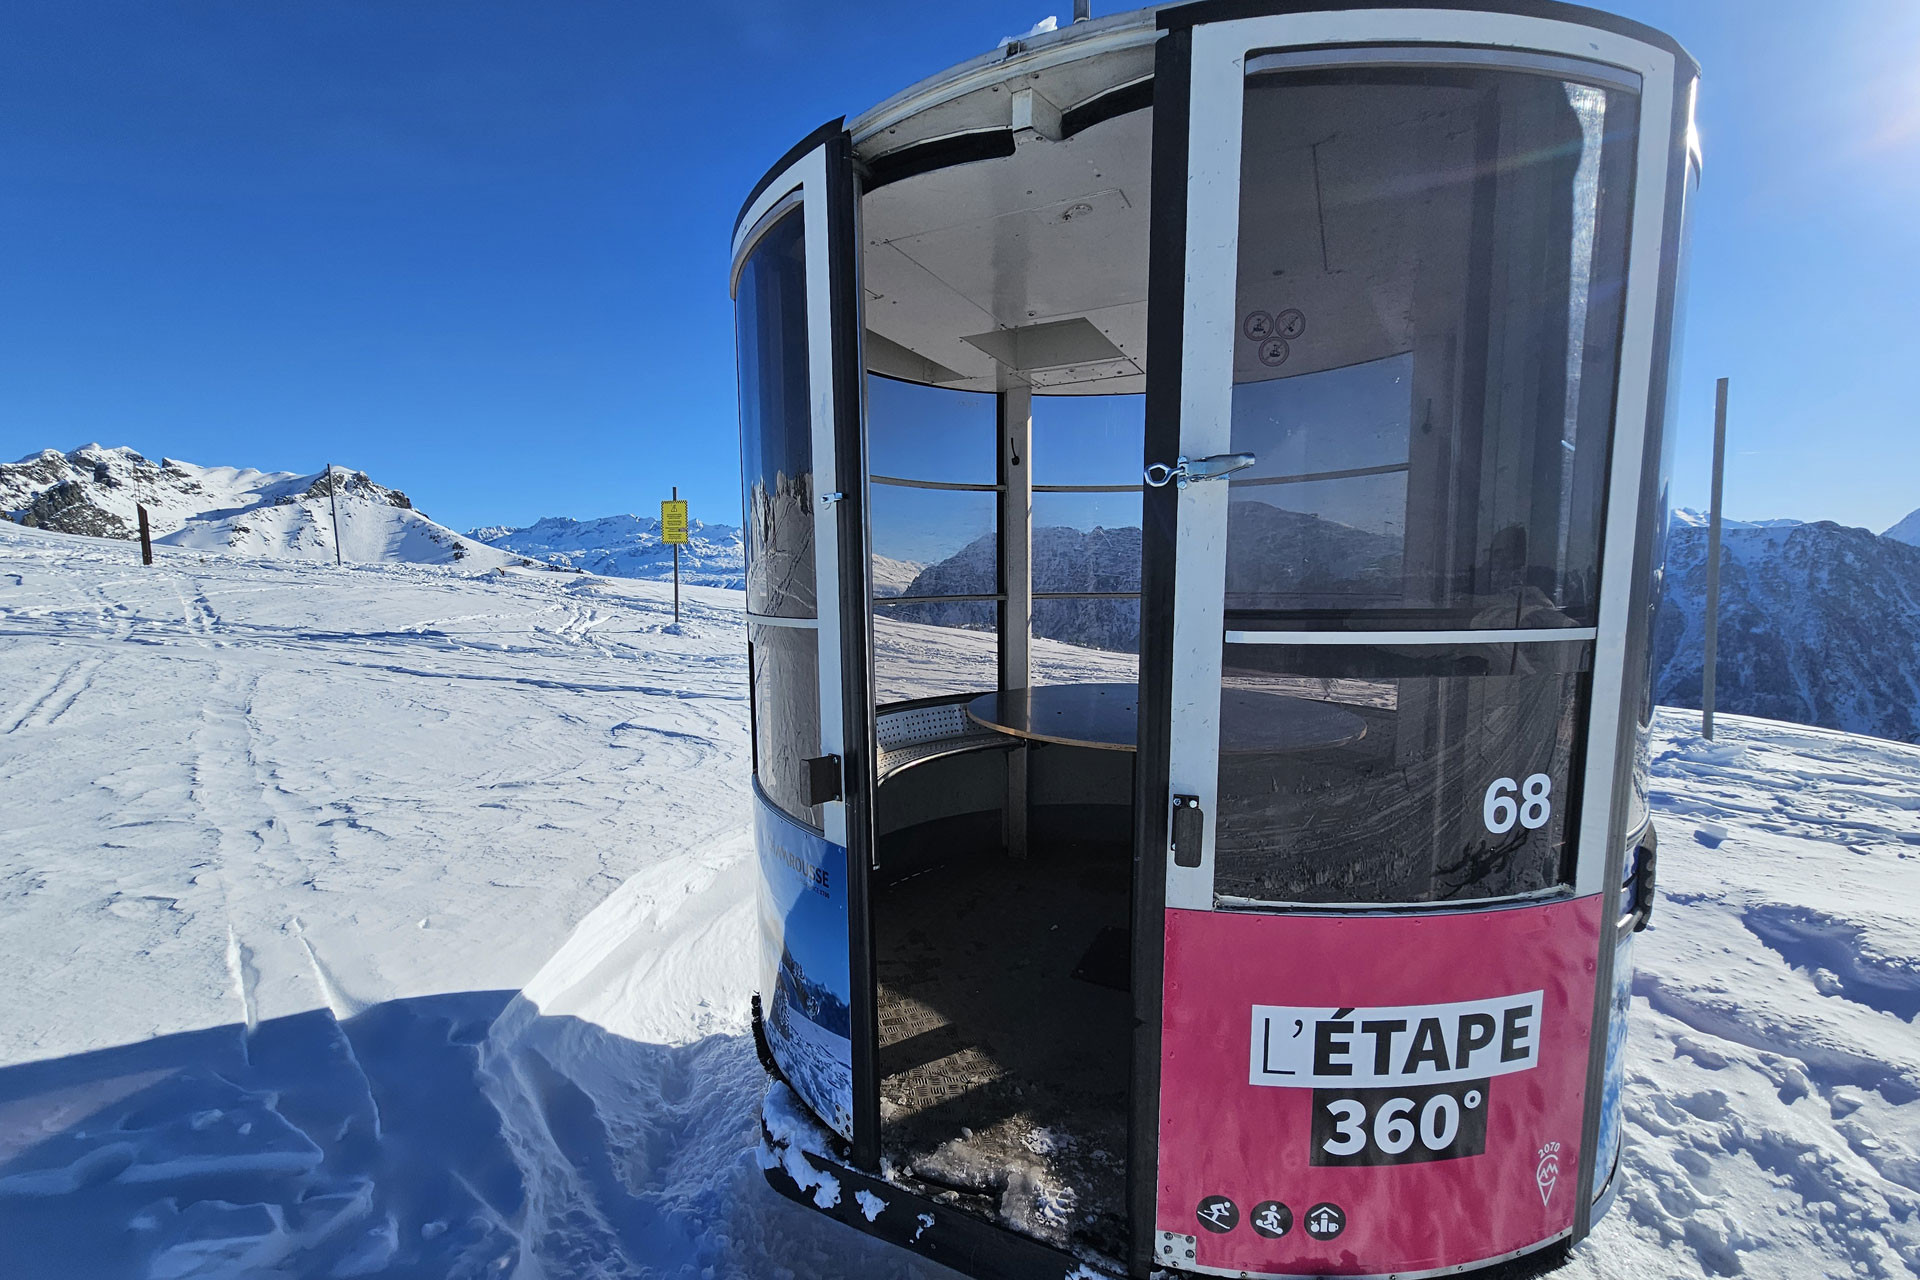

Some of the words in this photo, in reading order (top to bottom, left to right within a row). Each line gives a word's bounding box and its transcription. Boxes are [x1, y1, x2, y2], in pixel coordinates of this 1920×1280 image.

[1483, 773, 1551, 834] 68
[1262, 1004, 1533, 1076] L'ÉTAPE
[1322, 1089, 1482, 1156] 360°
[1538, 1142, 1560, 1158] 2070
